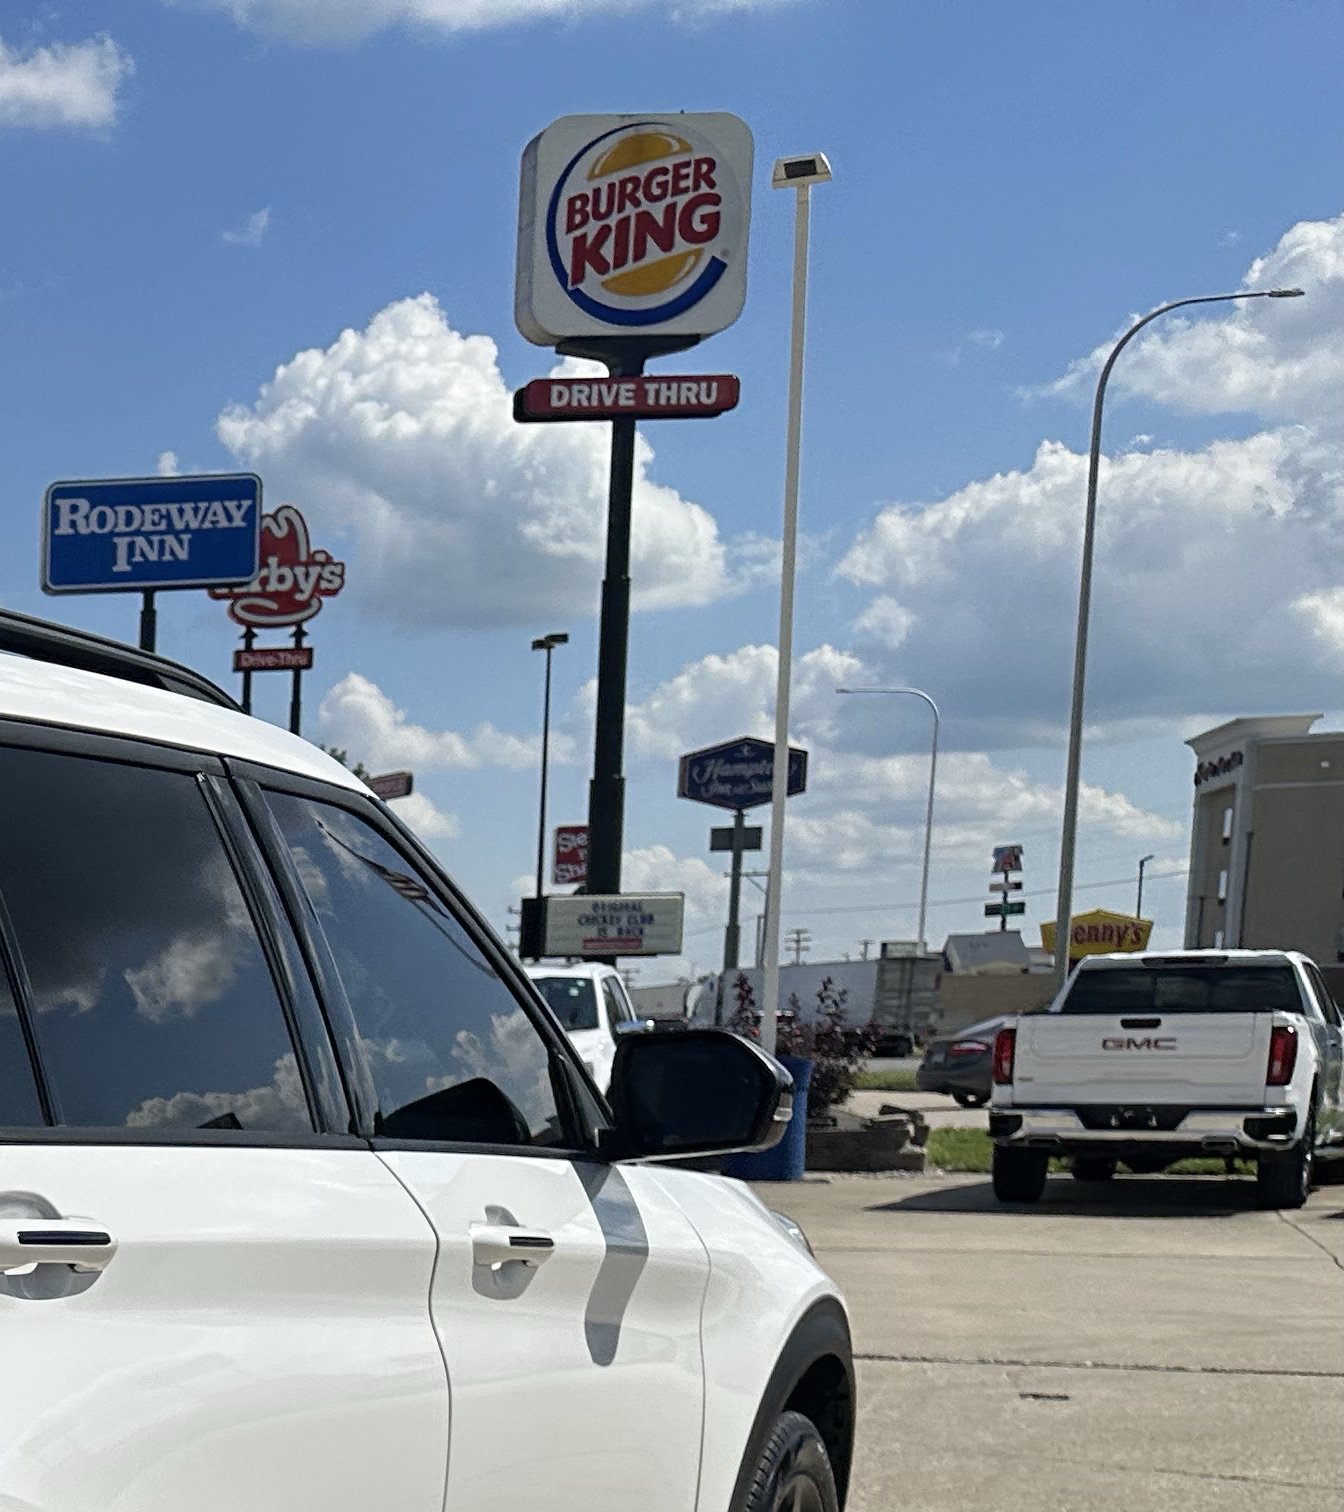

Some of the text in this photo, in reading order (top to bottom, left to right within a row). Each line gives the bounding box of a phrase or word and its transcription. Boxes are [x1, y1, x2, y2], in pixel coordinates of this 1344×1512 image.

[566, 157, 716, 235] BURGER
[571, 193, 721, 286] KING
[550, 382, 718, 407] DRIVE THRU
[55, 498, 252, 535] RODEWAY
[113, 534, 192, 572] INN
[215, 550, 345, 600] rby's
[1070, 922, 1144, 948] enny's
[1102, 1036, 1178, 1051] GMC
